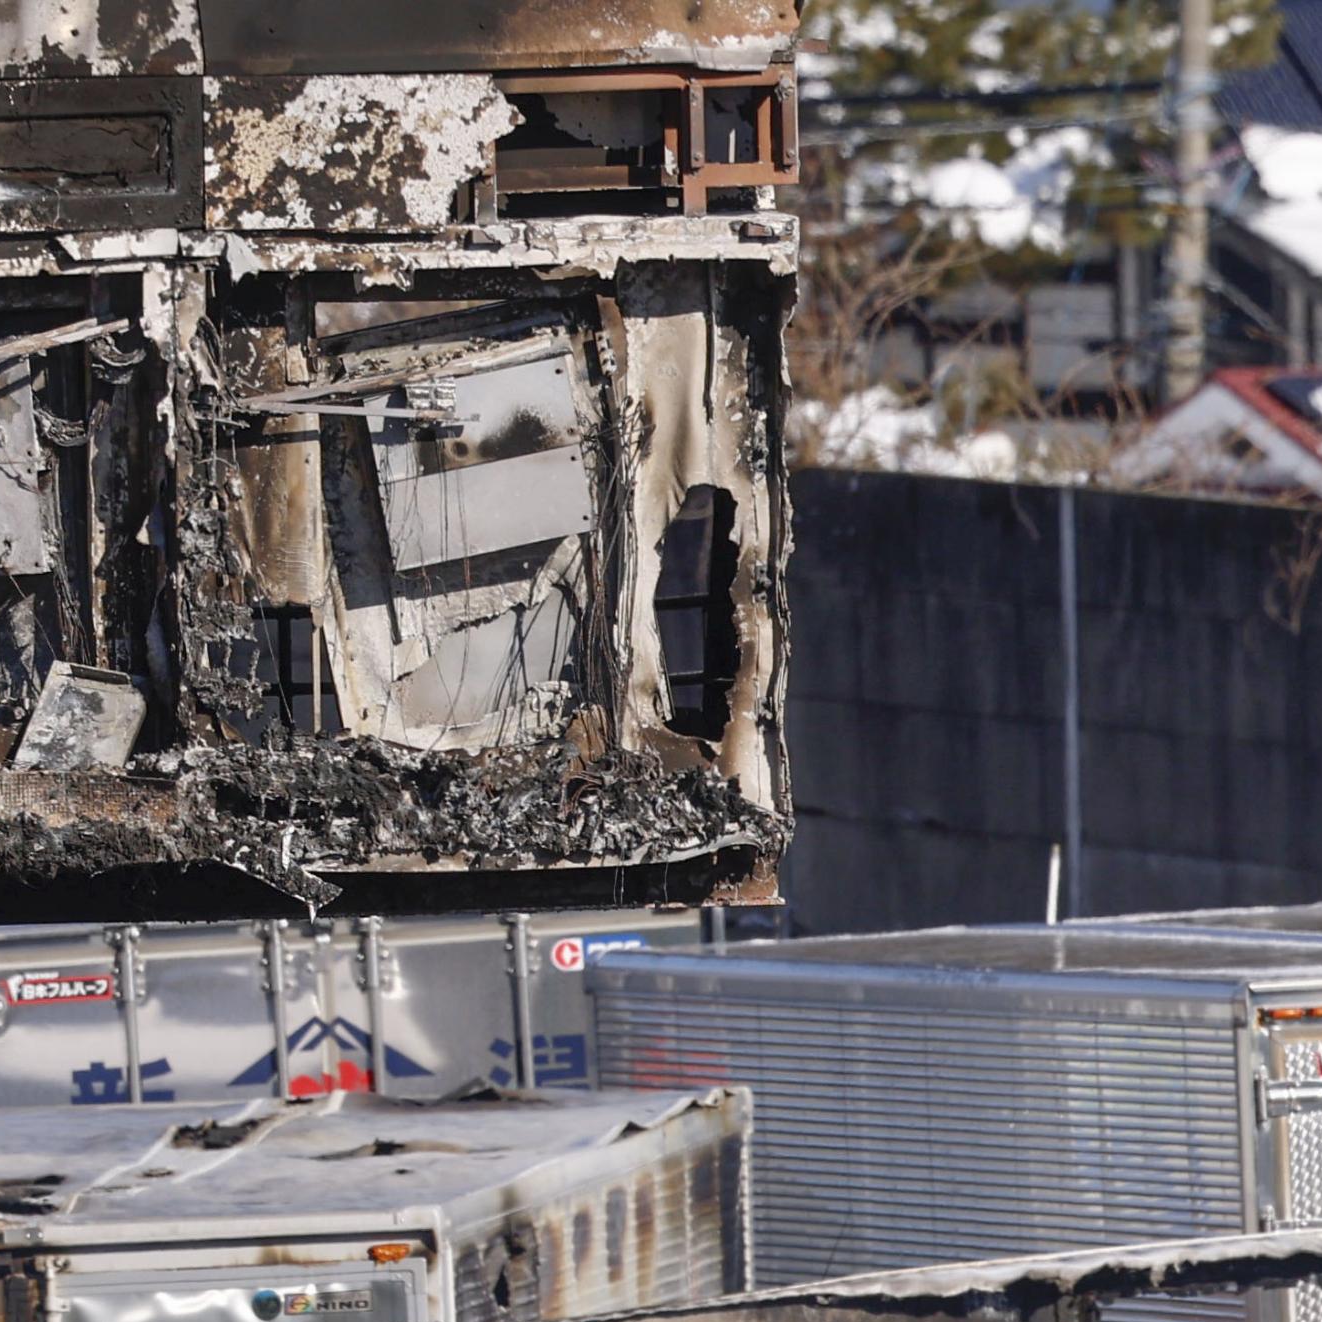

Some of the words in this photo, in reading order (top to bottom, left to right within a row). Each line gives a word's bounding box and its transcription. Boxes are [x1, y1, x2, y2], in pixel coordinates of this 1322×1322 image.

[22, 978, 109, 1001] 日本フルハーフ
